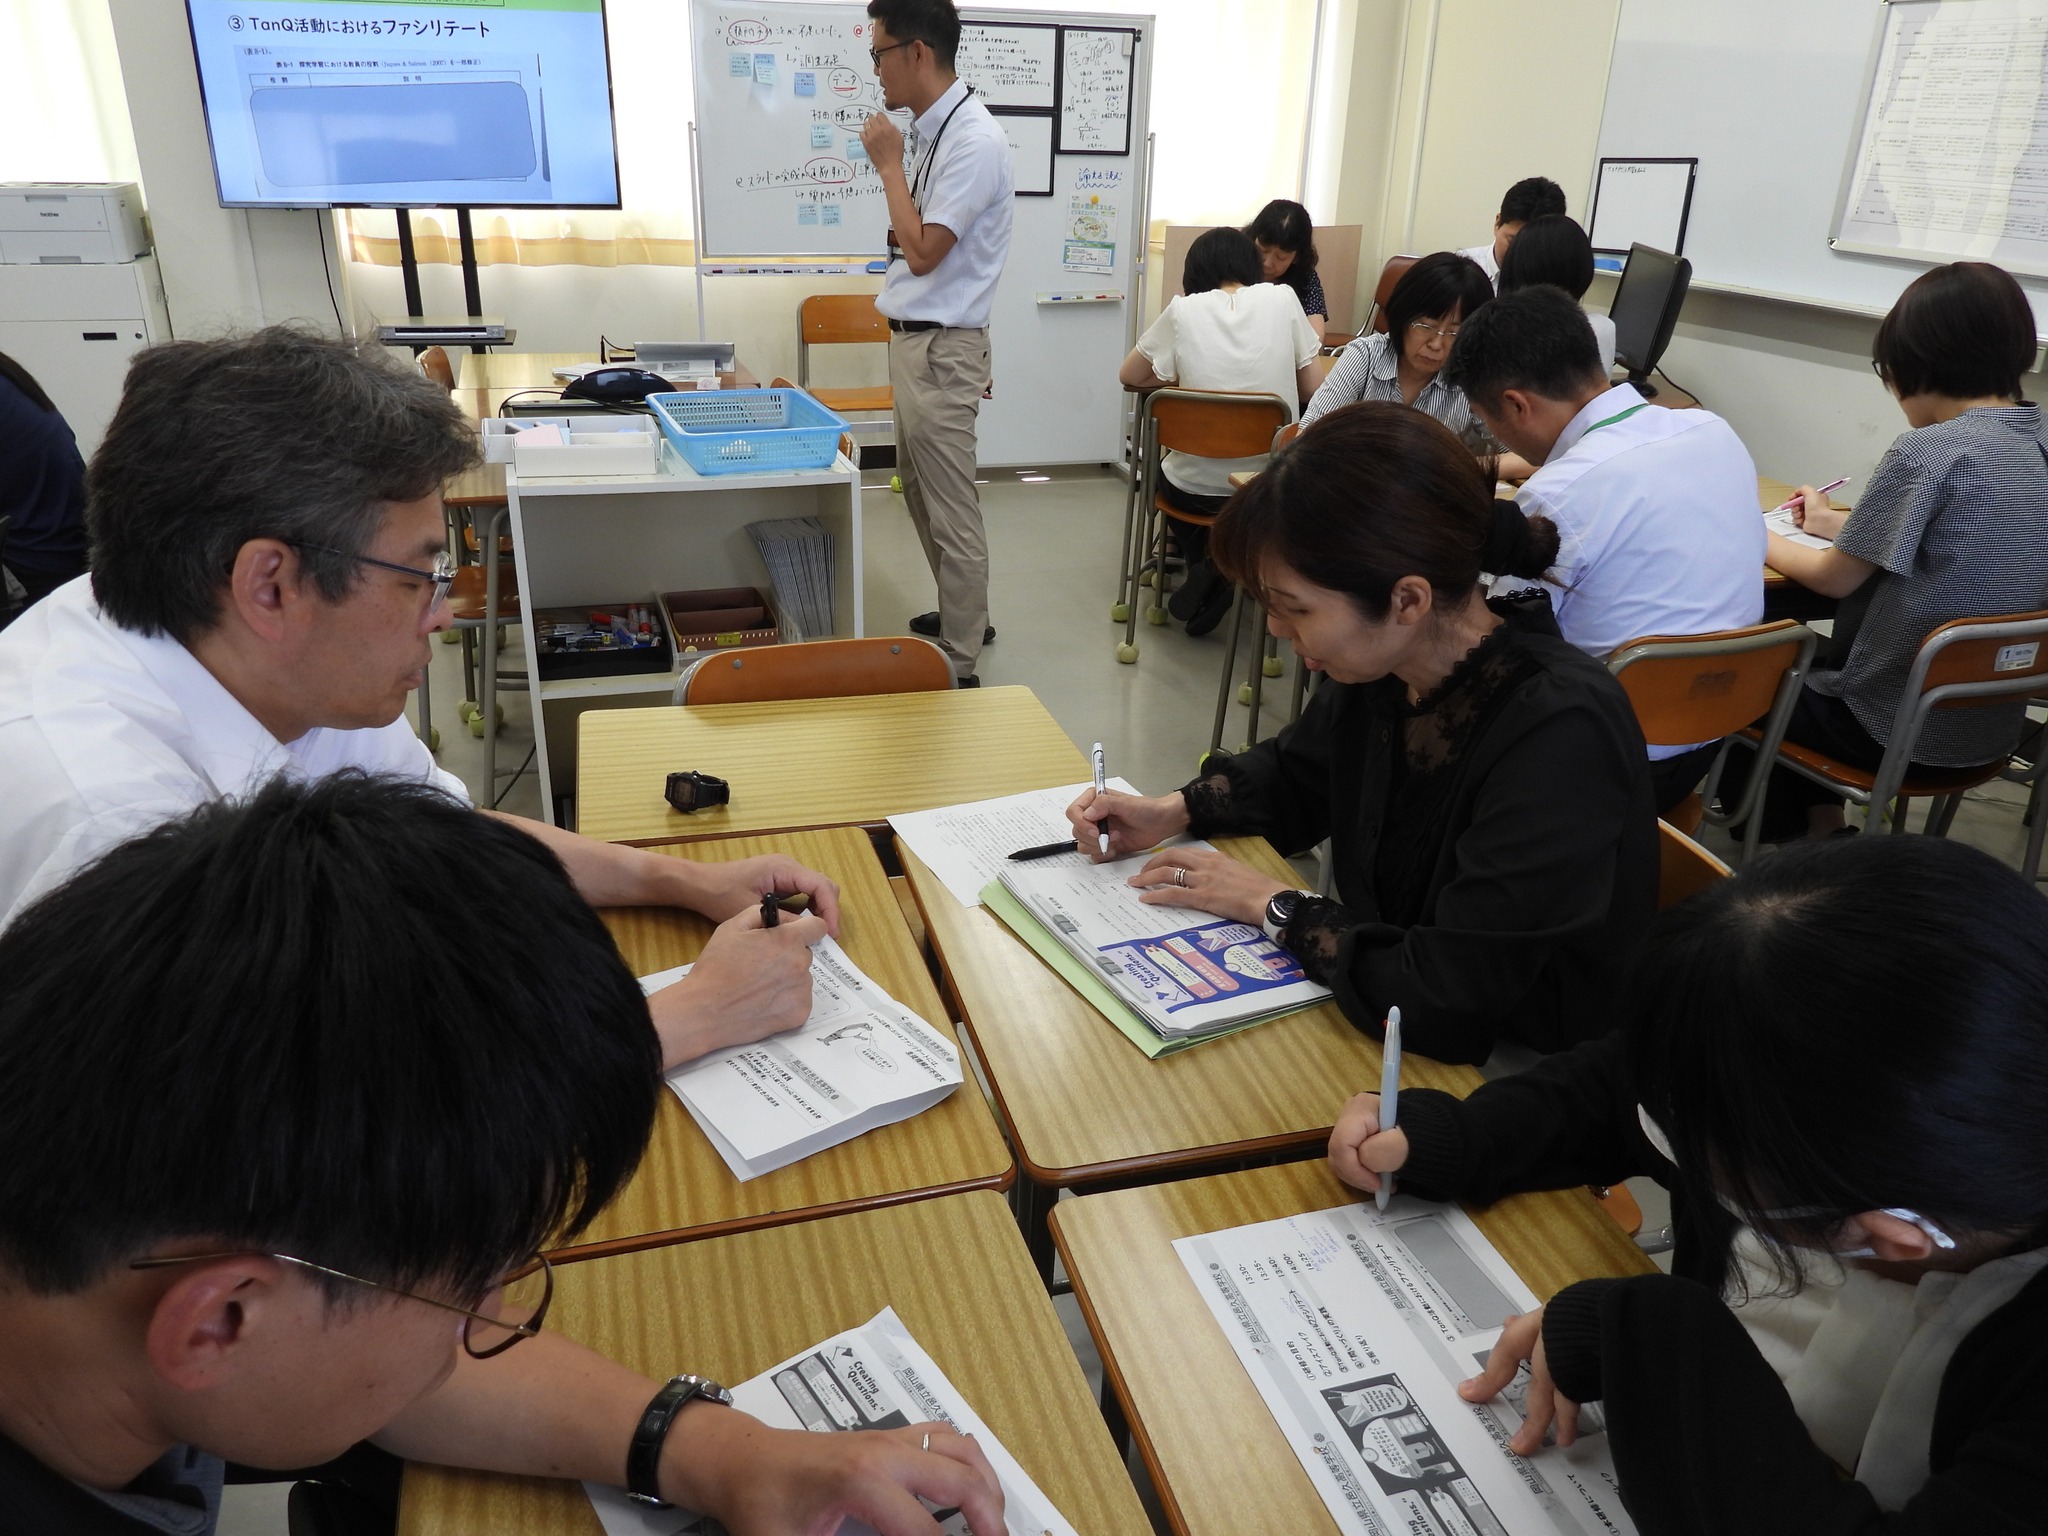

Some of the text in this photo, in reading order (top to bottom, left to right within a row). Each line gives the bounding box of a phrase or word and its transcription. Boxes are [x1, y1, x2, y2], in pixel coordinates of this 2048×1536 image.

[249, 16, 490, 38] TanQ活動におけるファシリテート
[1122, 962, 1154, 989] Creating
[1212, 1272, 1261, 1343] 岡山県立邑久高等学校
[1350, 1242, 1405, 1309] 岡山県立邑久高等学校
[1374, 1242, 1448, 1333] TanQ活動におけるファシリテート
[850, 1359, 882, 1395] Creating
[1285, 1340, 1316, 1380] ①研修の目的
[1471, 1405, 1543, 1494] 岡山県立邑久高等学校
[1566, 1472, 1621, 1536] ①本研修について
